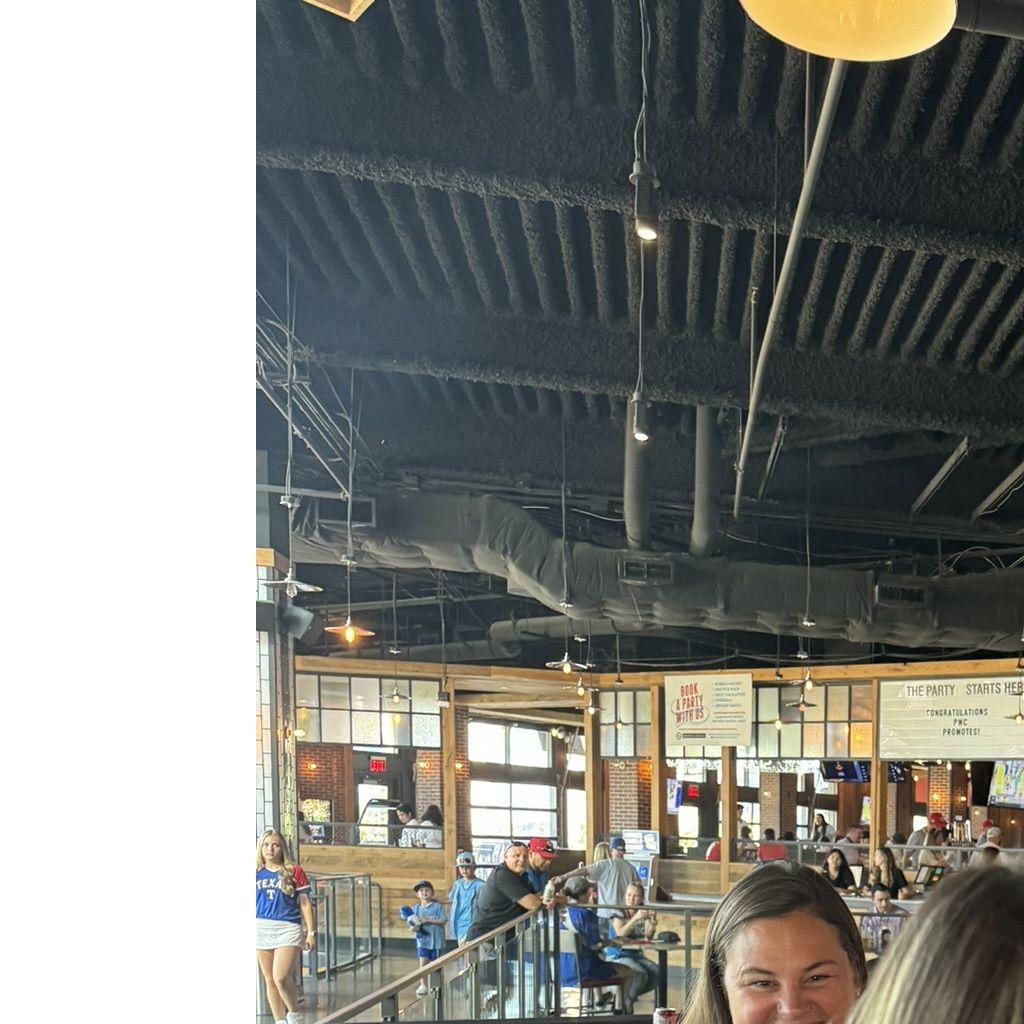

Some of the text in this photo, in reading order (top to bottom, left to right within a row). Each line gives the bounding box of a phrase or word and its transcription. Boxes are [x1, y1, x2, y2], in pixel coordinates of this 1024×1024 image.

[680, 683, 699, 697] BOOK
[906, 685, 924, 697] THE
[926, 684, 956, 697] PARTY
[965, 682, 1001, 696] STARTS
[676, 694, 704, 711] A PARTY
[675, 709, 694, 723] WITH
[695, 707, 704, 720] US
[926, 708, 988, 717] CONGRATULATIONS
[942, 728, 980, 736] PROMOTES!
[256, 879, 283, 890] TEXA
